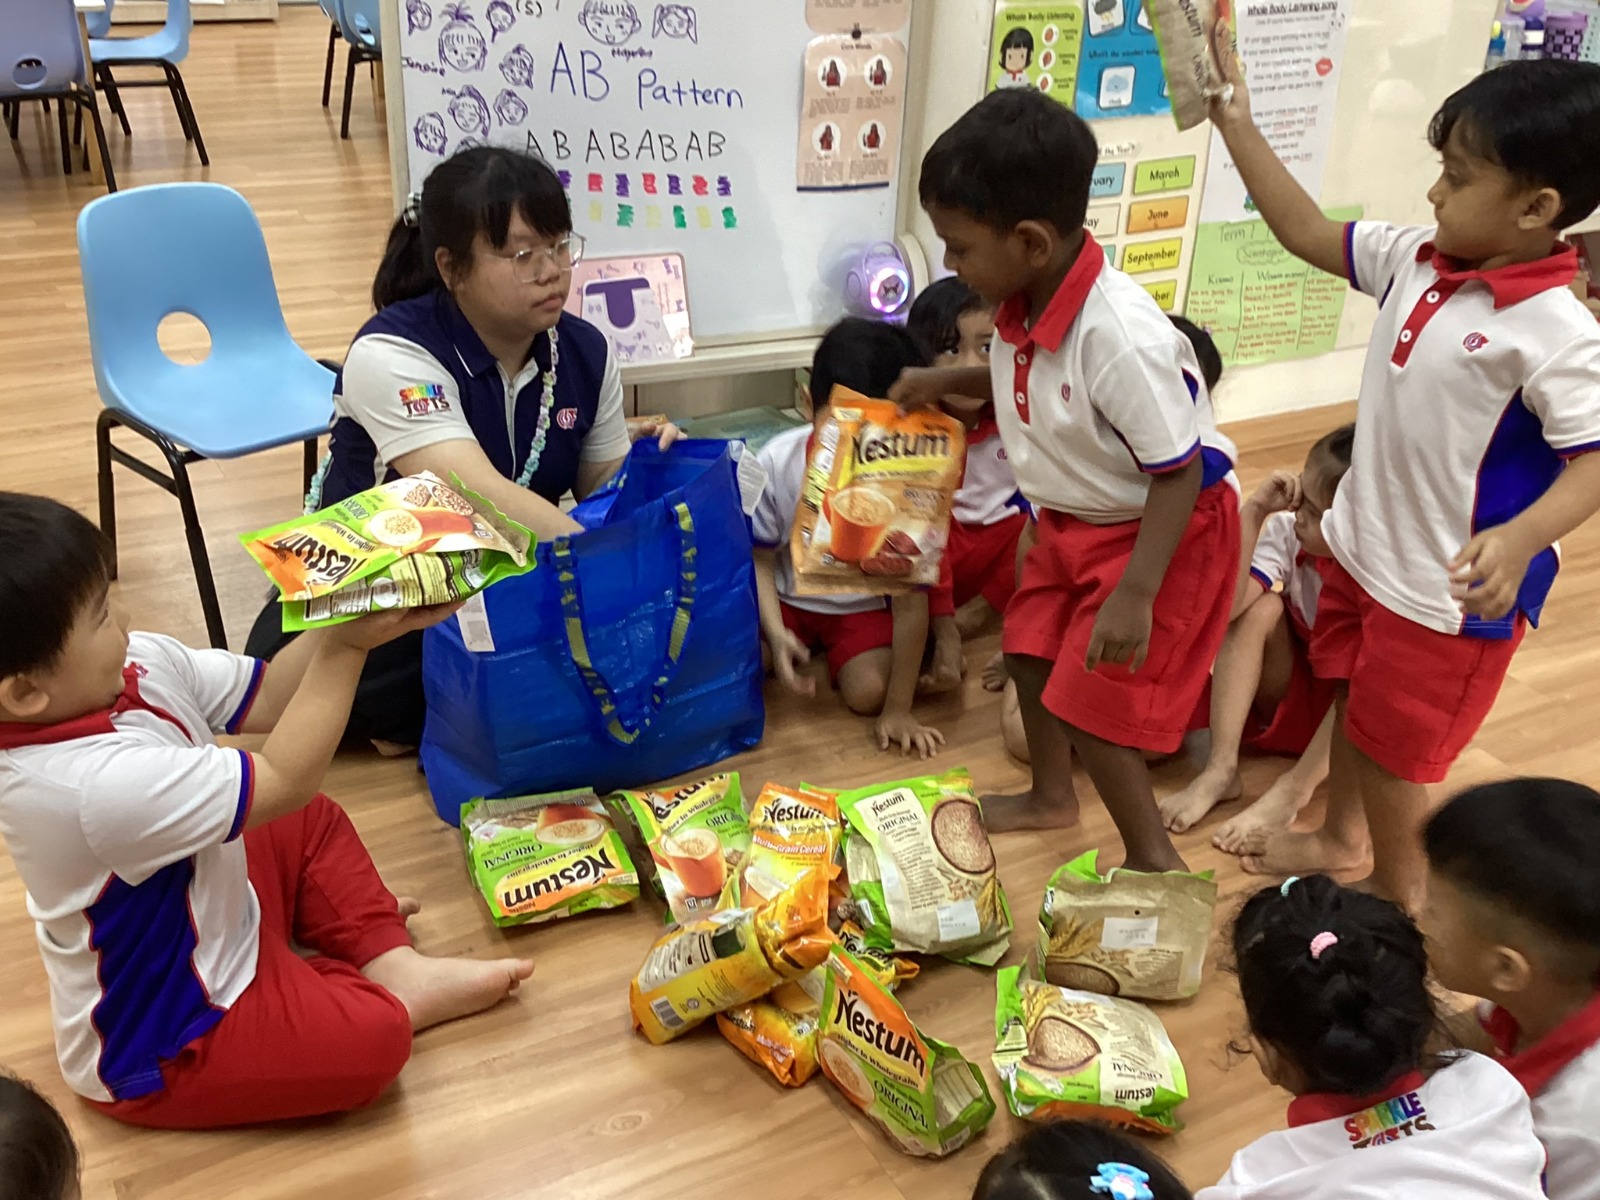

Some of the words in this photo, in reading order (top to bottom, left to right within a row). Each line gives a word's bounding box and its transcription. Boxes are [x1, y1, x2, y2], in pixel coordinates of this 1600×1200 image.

[638, 68, 744, 110] Pattern
[1149, 165, 1180, 182] March
[1147, 208, 1169, 221] June
[1127, 248, 1178, 265] September
[585, 277, 651, 329] T
[870, 792, 907, 818] Nestum
[877, 812, 920, 833] ORIGINAL
[484, 843, 543, 870] ORIGINAL
[800, 842, 827, 854] Cereal
[504, 846, 617, 909] Nestum
[833, 987, 926, 1078] Nestum
[1114, 1086, 1156, 1101] estum
